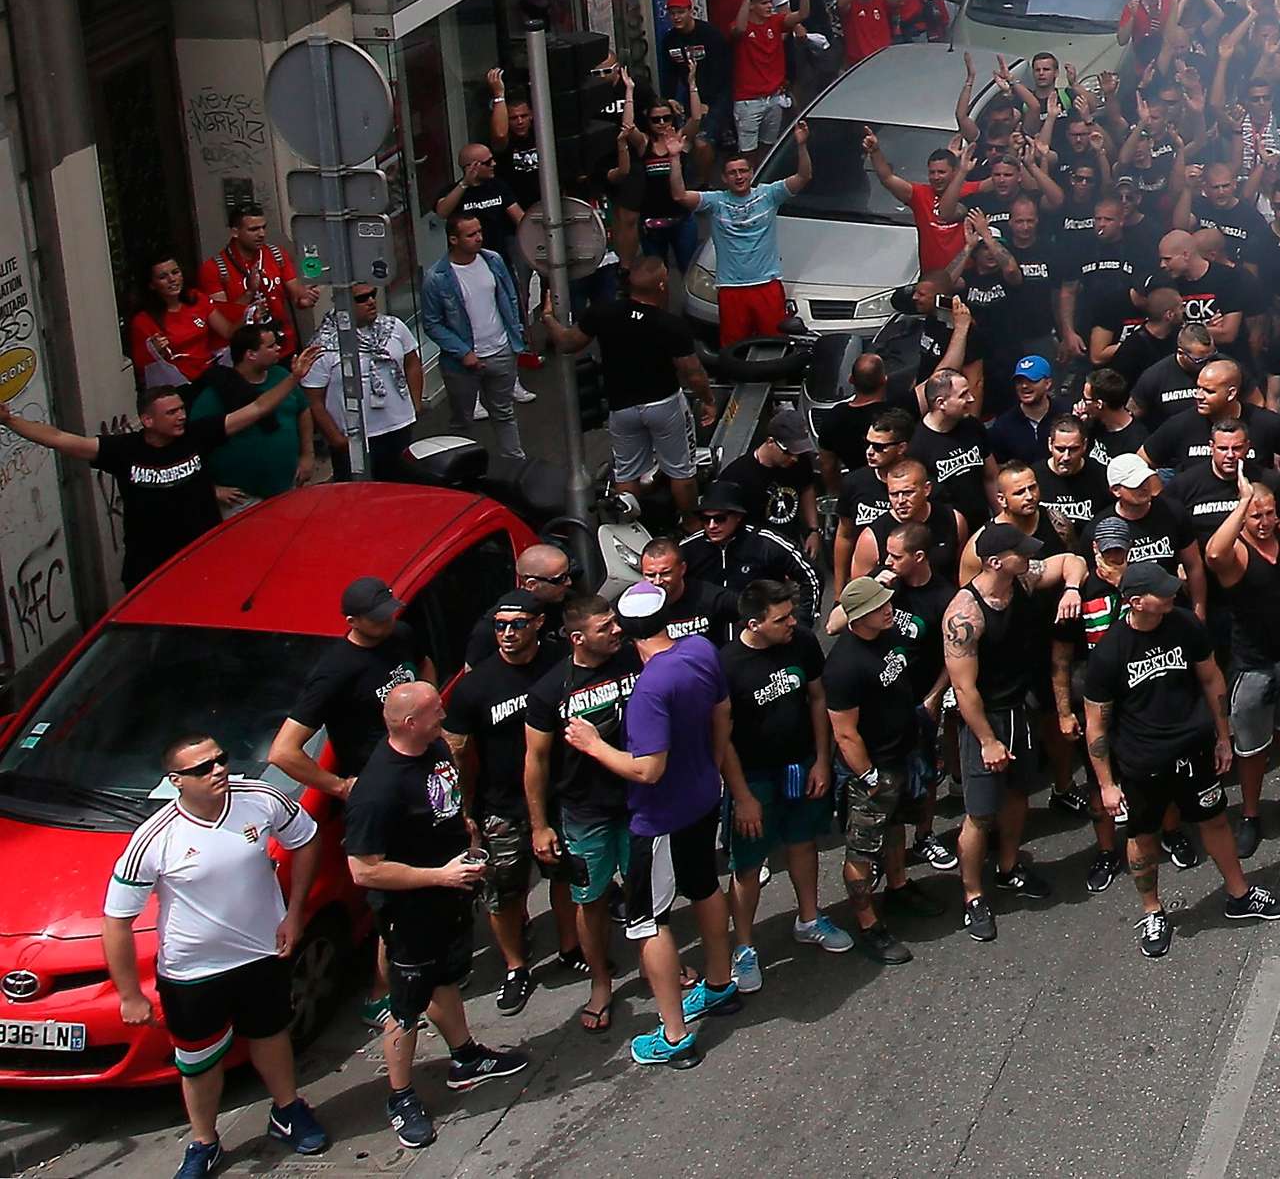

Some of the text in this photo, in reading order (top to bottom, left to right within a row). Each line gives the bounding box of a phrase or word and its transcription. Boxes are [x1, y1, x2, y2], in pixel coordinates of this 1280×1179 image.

[937, 446, 984, 477] SZEKTOR
[770, 668, 786, 682] THE
[1127, 647, 1187, 682] SZEKTOR
[754, 677, 791, 700] EASTERN
[72, 1038, 82, 1049] 13
